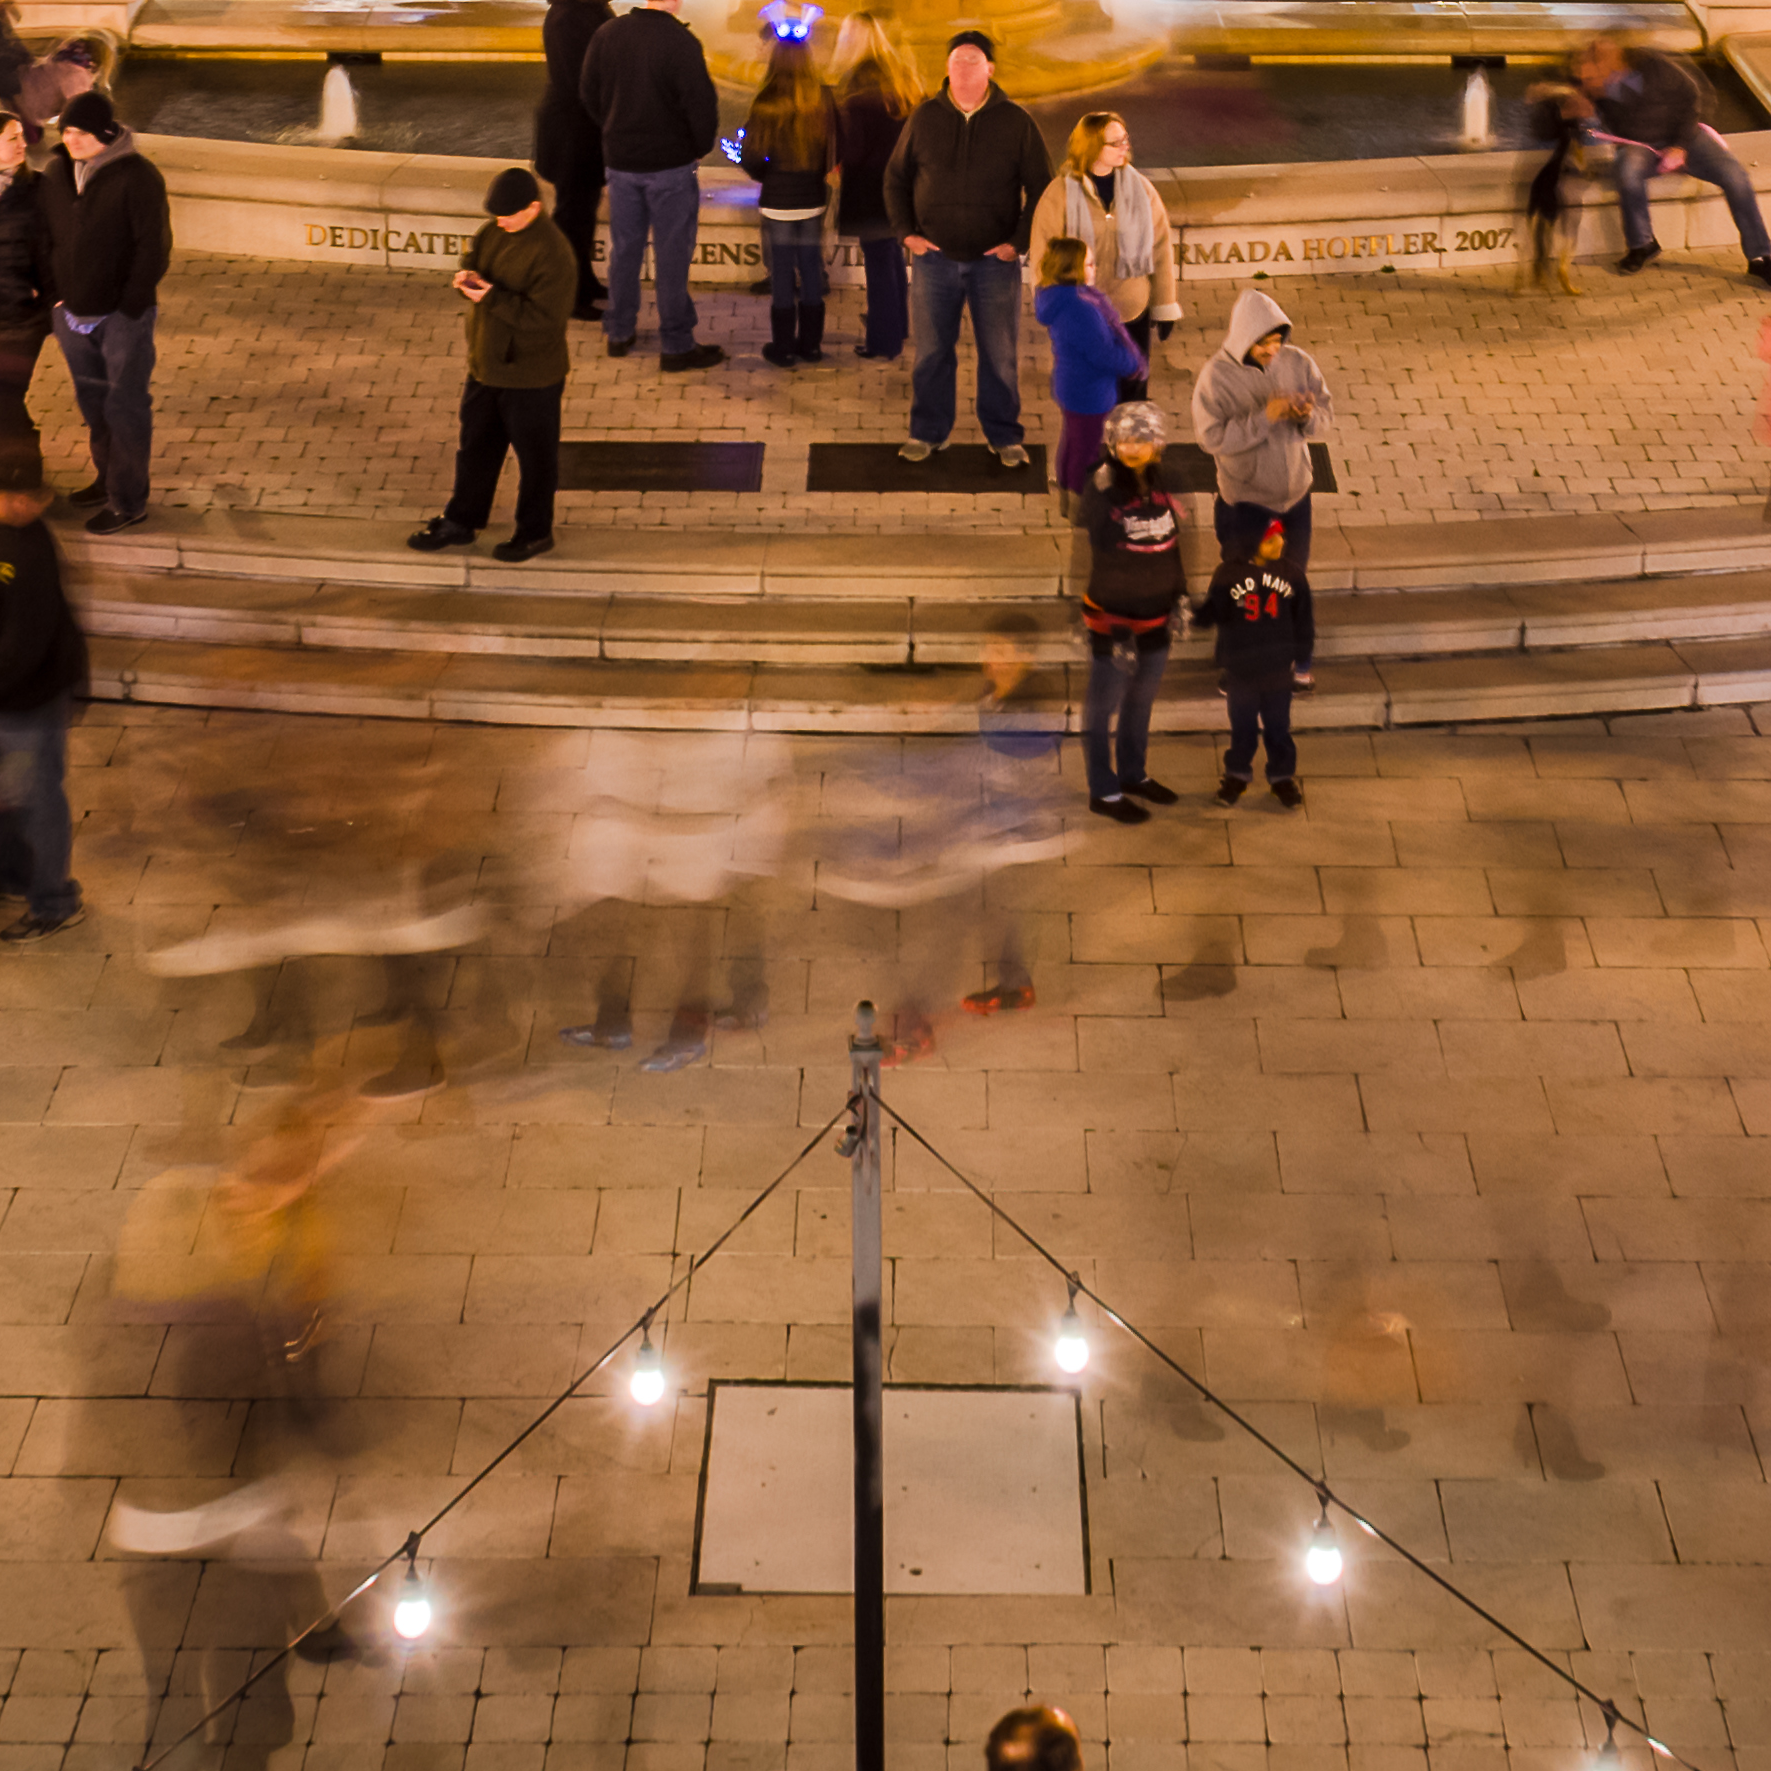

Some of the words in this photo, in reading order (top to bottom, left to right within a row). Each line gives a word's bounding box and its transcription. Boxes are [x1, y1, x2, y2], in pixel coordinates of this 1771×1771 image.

[1172, 238, 1295, 265] RMADA
[1230, 577, 1255, 601] OLD
[1262, 573, 1295, 599] NAVY
[1245, 592, 1278, 621] 94
